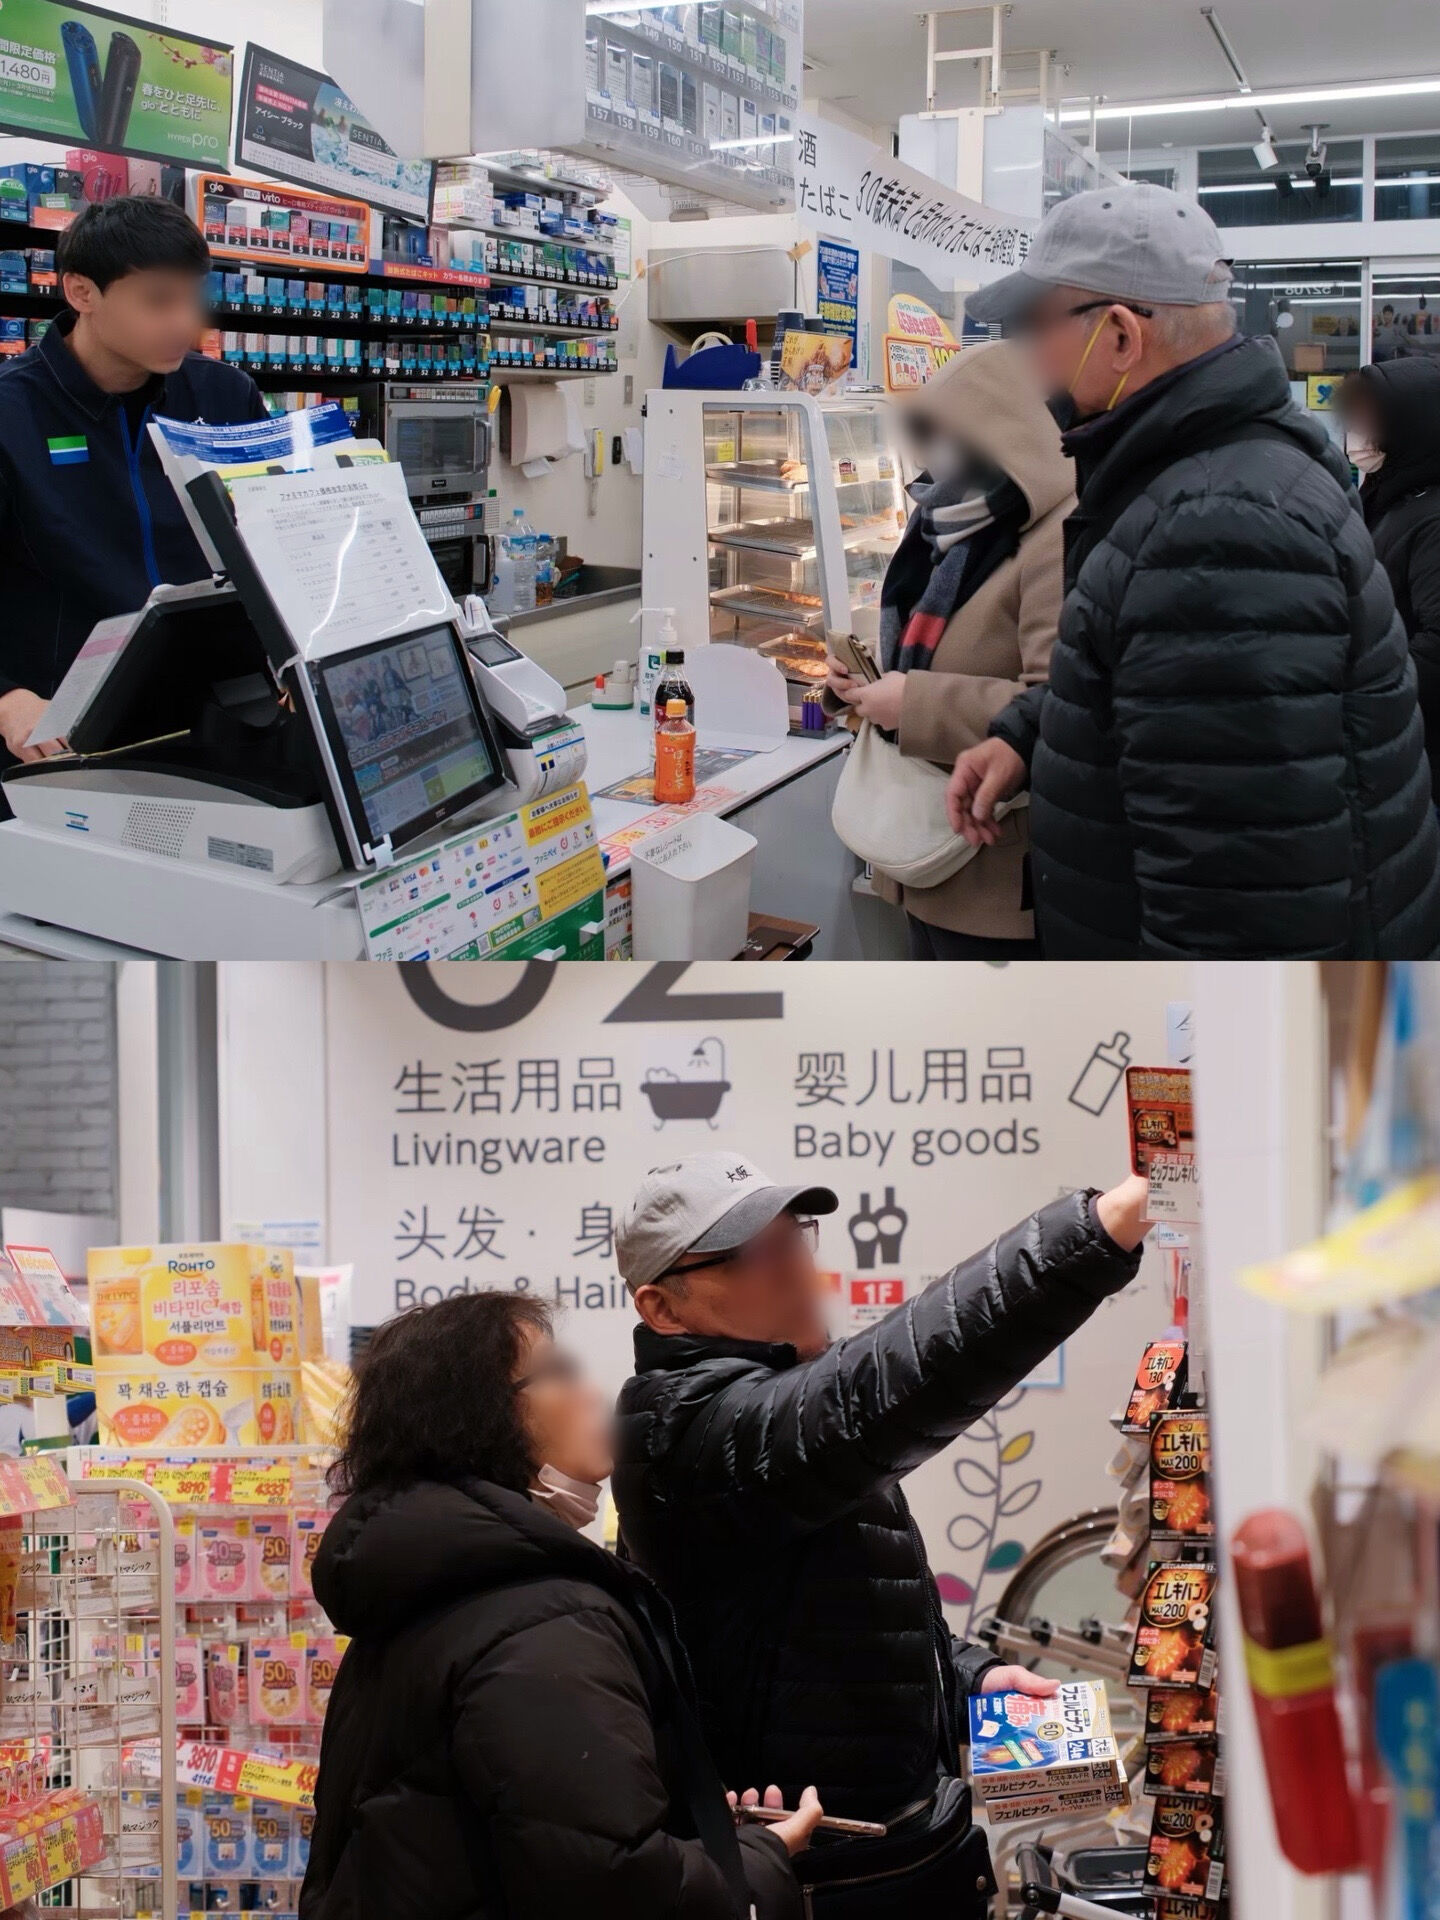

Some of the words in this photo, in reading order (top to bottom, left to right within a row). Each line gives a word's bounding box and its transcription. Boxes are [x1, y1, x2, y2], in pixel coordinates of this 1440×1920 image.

[645, 26, 660, 41] 149
[667, 38, 682, 52] 150
[690, 49, 702, 62] 151
[712, 60, 725, 74] 152
[731, 69, 744, 84] 153
[749, 78, 762, 91] 154
[767, 87, 780, 100] 155
[590, 106, 609, 121] 157
[616, 116, 634, 130] 158
[643, 124, 659, 139] 159
[666, 133, 681, 147] 160
[690, 142, 704, 154] 161
[798, 129, 817, 168] 酒
[799, 177, 852, 221] たばこ
[38, 285, 50, 295] 11
[272, 306, 282, 314] 20
[293, 308, 302, 316] 21
[312, 310, 322, 318] 22
[252, 362, 262, 370] 43
[292, 364, 302, 372] 45
[534, 847, 557, 864] ファミペイ
[403, 873, 416, 884] VISA
[394, 1057, 621, 1115] 生活用品
[794, 1047, 1031, 1107] 婴儿用品
[393, 1132, 606, 1175] Livingware
[794, 1122, 895, 1167] Baby
[912, 1119, 1040, 1166] goods
[725, 1165, 752, 1183] 大阪
[168, 1258, 215, 1274] ROHTO
[172, 1279, 221, 1296] 리포솜
[863, 1282, 894, 1304] 1F
[153, 1300, 215, 1317] 비타민C
[169, 1319, 227, 1333] 서플리먼트
[1145, 1357, 1175, 1370] エレキバン
[1149, 1372, 1162, 1383] 130
[139, 1381, 169, 1398] 채운
[176, 1381, 191, 1398] 한
[198, 1380, 229, 1398] 캡슐
[1178, 1422, 1193, 1432] ピップ
[1161, 1459, 1174, 1468] MAX
[1174, 1455, 1199, 1470] 200
[177, 1481, 206, 1493] 3810
[264, 1537, 286, 1557] 50
[1174, 1572, 1188, 1580] ピップ
[1154, 1582, 1204, 1601] エレキバン
[1151, 1606, 1163, 1615] MAX
[1163, 1603, 1187, 1618] 200
[1062, 1686, 1084, 1734] フェルビナク
[1093, 1739, 1112, 1755] 大判
[187, 1745, 219, 1774] 3810
[982, 1780, 1038, 1794] フェルビナク
[995, 1805, 1050, 1820] フェルビナク
[211, 1820, 231, 1837] 50
[1173, 1813, 1194, 1829] 200
[257, 1820, 278, 1838] 50
